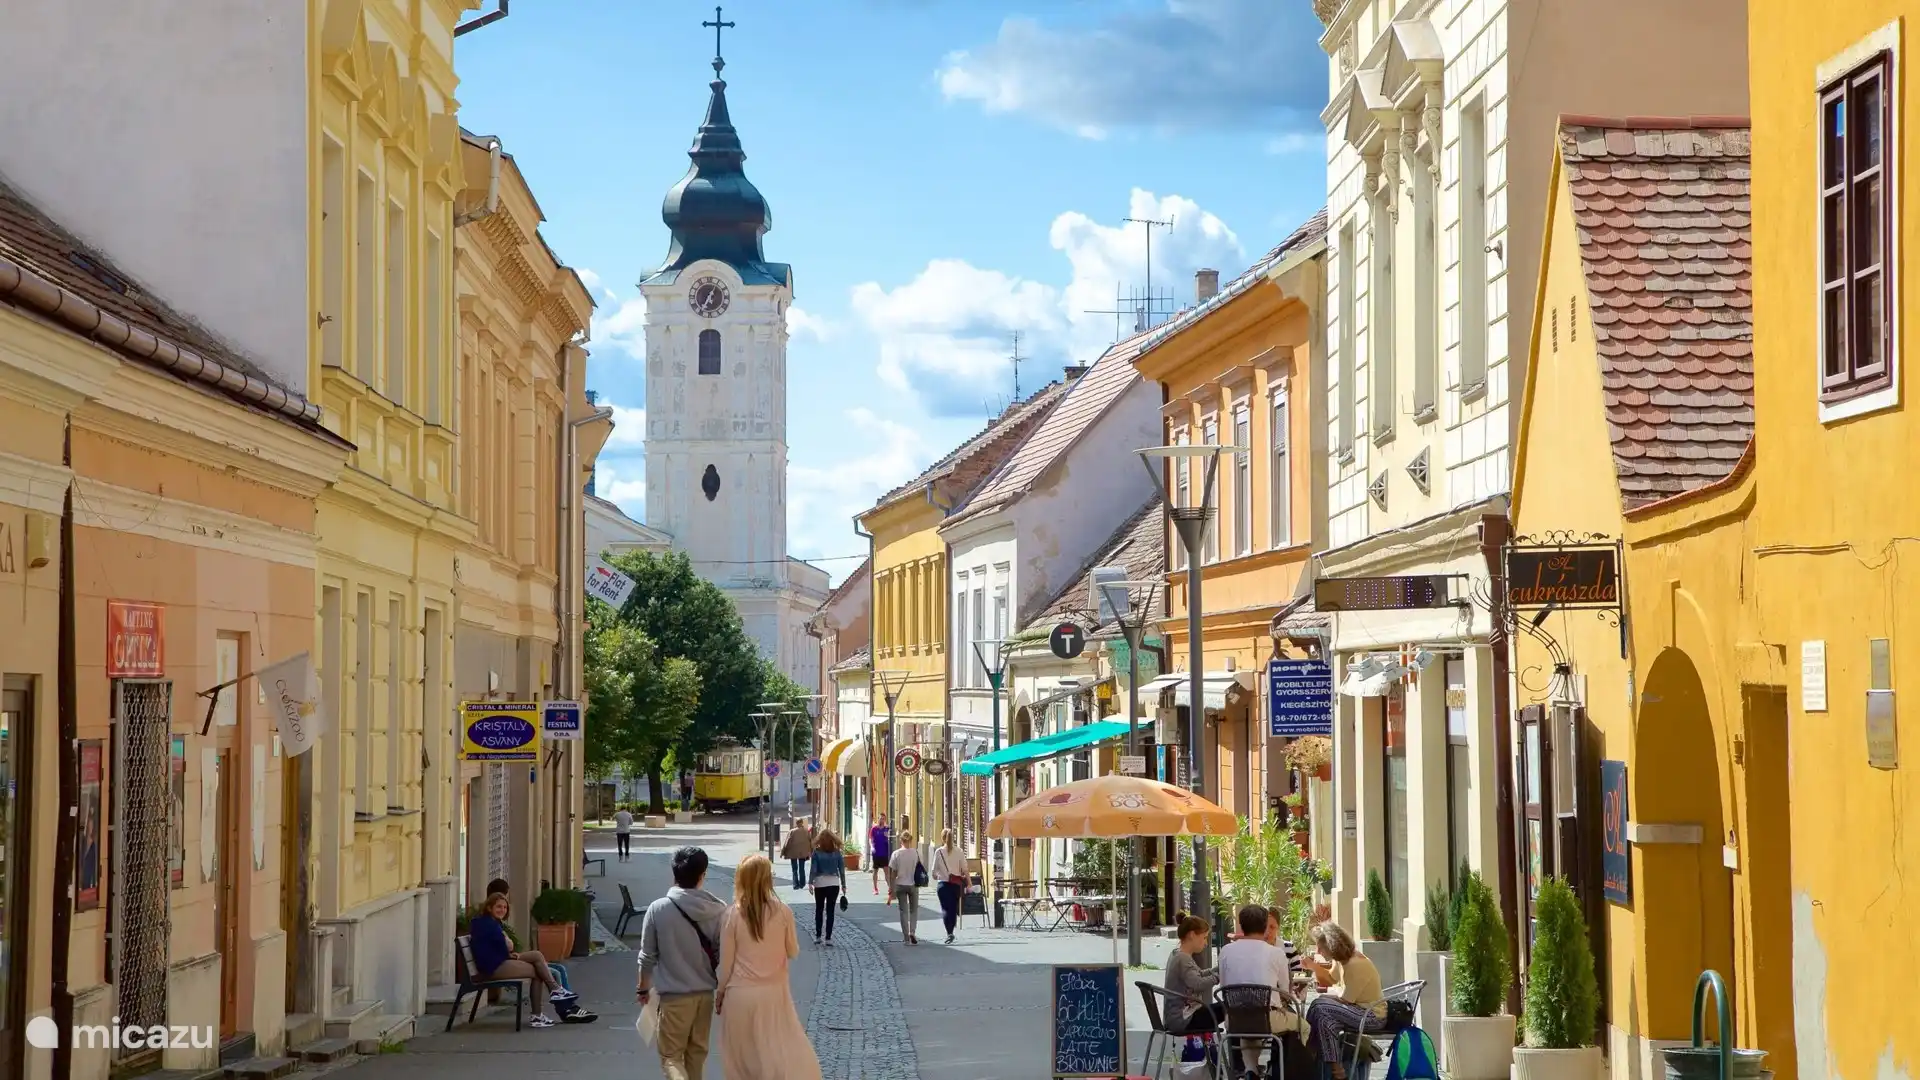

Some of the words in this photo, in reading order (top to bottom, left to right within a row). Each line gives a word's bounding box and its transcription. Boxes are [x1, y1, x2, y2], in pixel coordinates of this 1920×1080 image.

[587, 573, 600, 588] for
[599, 581, 620, 600] Rent
[608, 572, 627, 590] Flat
[1509, 560, 1615, 602] cukrászda
[1057, 1040, 1102, 1056] LATTE
[1056, 1055, 1118, 1073] BROWNIE
